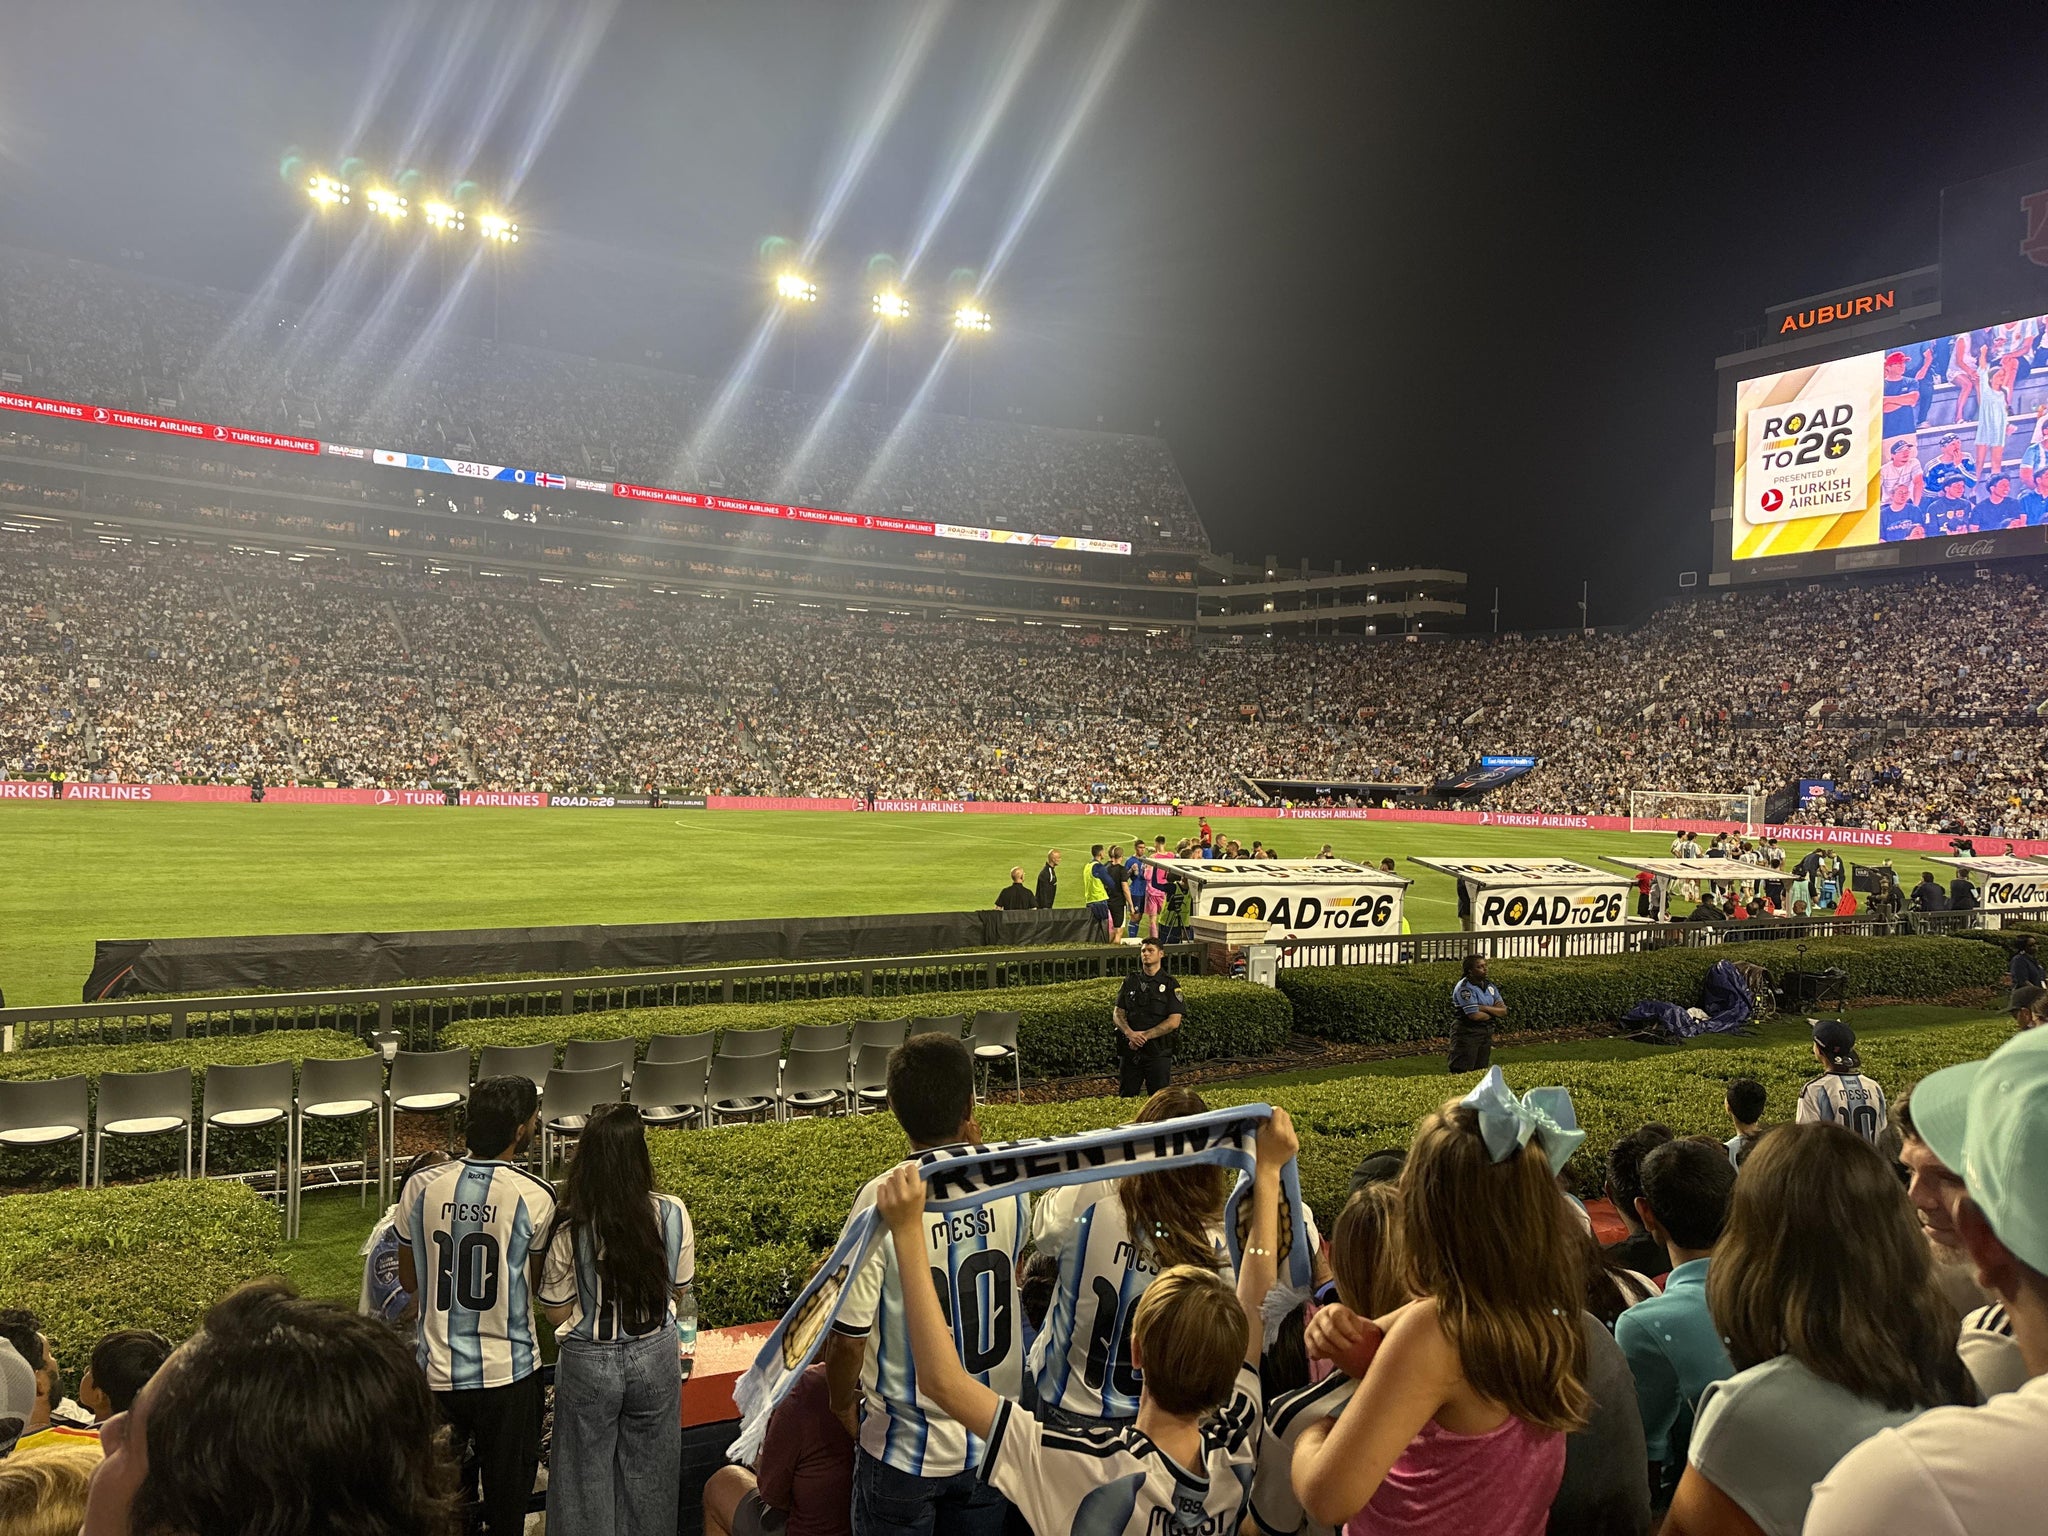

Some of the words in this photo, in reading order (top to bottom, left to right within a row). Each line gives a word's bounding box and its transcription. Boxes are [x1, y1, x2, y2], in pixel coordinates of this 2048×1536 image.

[1780, 290, 1895, 334] AUBURN
[35, 402, 83, 416] AIRLINES
[113, 414, 157, 428] TURKISH
[159, 421, 204, 435] AIRLINES
[1762, 404, 1853, 440] ROAD
[231, 431, 272, 446] TURKISH
[274, 438, 315, 452] AIRLINES
[457, 462, 490, 477] 24:15
[1761, 450, 1793, 471] TO
[1773, 470, 1824, 484] PRESENTED
[1825, 468, 1838, 477] BY
[631, 488, 663, 500] TURKISH
[664, 493, 697, 504] AIRLINES
[1790, 478, 1851, 496] TURKISH
[717, 500, 748, 511] TURKISH
[749, 504, 779, 515] AIRLINES
[1789, 491, 1851, 509] AIRLINES
[798, 510, 827, 521] TURKISH
[828, 514, 858, 524] AIRLINES
[875, 519, 903, 530] TURKISH
[904, 523, 933, 533] AIRLINES
[1945, 538, 1997, 558] Coca-Cola
[0, 784, 53, 799] RKIS
[68, 785, 152, 800] AIRLINES
[207, 789, 279, 801] TURKH
[405, 792, 470, 805] TURKH
[475, 793, 539, 806] AIRLINES
[551, 796, 589, 807] ROAD
[598, 796, 615, 807] 26
[873, 801, 917, 812] TURKISH
[920, 802, 965, 812] AIRLINES
[1101, 806, 1138, 815] TURKISH
[1140, 806, 1173, 816] AIRLINE
[1291, 810, 1332, 819] TURKISH
[1333, 810, 1367, 819] AIRLINES
[1496, 814, 1539, 826] TURKISH
[1541, 816, 1587, 827] AIRLINES
[1764, 826, 1824, 842] TURKISH
[1827, 831, 1892, 846] AIRLINES
[1173, 864, 1288, 874] ROAD
[1987, 882, 2036, 904] ROAD
[1209, 897, 1321, 930] ROAD
[1323, 910, 1349, 929] TO
[1350, 895, 1394, 928] 26
[1482, 896, 1571, 926] ROAD
[1571, 908, 1590, 924] TO
[1590, 893, 1622, 924] 26
[1839, 1089, 1872, 1101] MESSI
[1838, 1105, 1877, 1143] 10
[441, 1202, 497, 1223] MESSI
[931, 1208, 996, 1249] MESSI
[1113, 1241, 1162, 1276] MES
[432, 1229, 500, 1312] 10
[1179, 1496, 1203, 1514] 189
